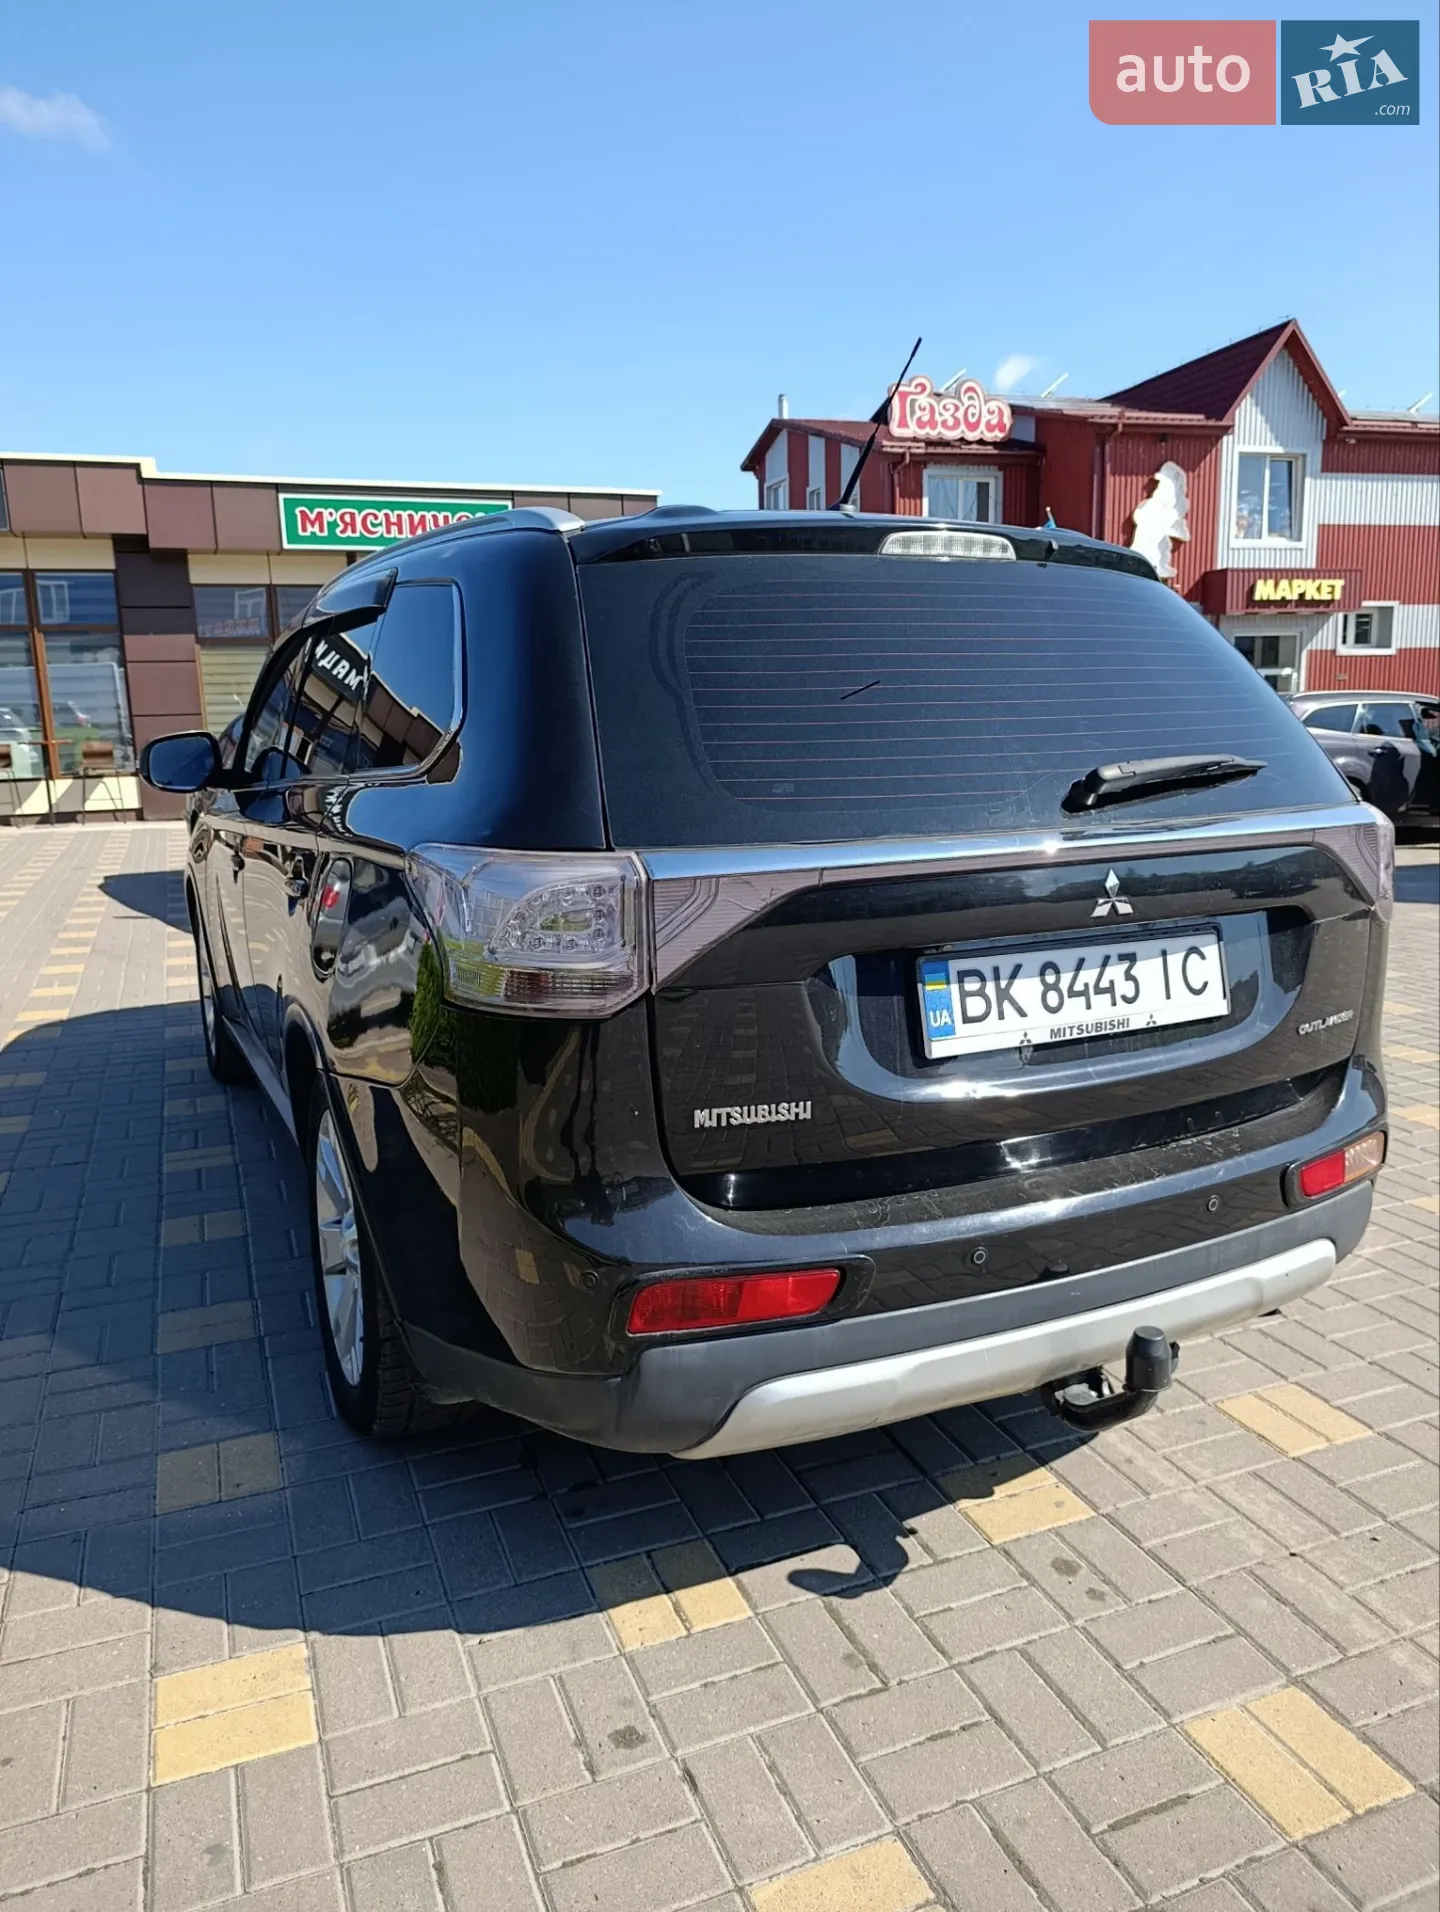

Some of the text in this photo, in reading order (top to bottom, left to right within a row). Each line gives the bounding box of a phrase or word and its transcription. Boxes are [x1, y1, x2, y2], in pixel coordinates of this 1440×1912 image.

[1253, 579, 1345, 601] МАРКЕТ
[957, 946, 1209, 1025] BK 8443 IC
[929, 1010, 952, 1028] UA
[1049, 1017, 1131, 1040] MITSUBISHI
[693, 1100, 812, 1129] MITSUBISHI
